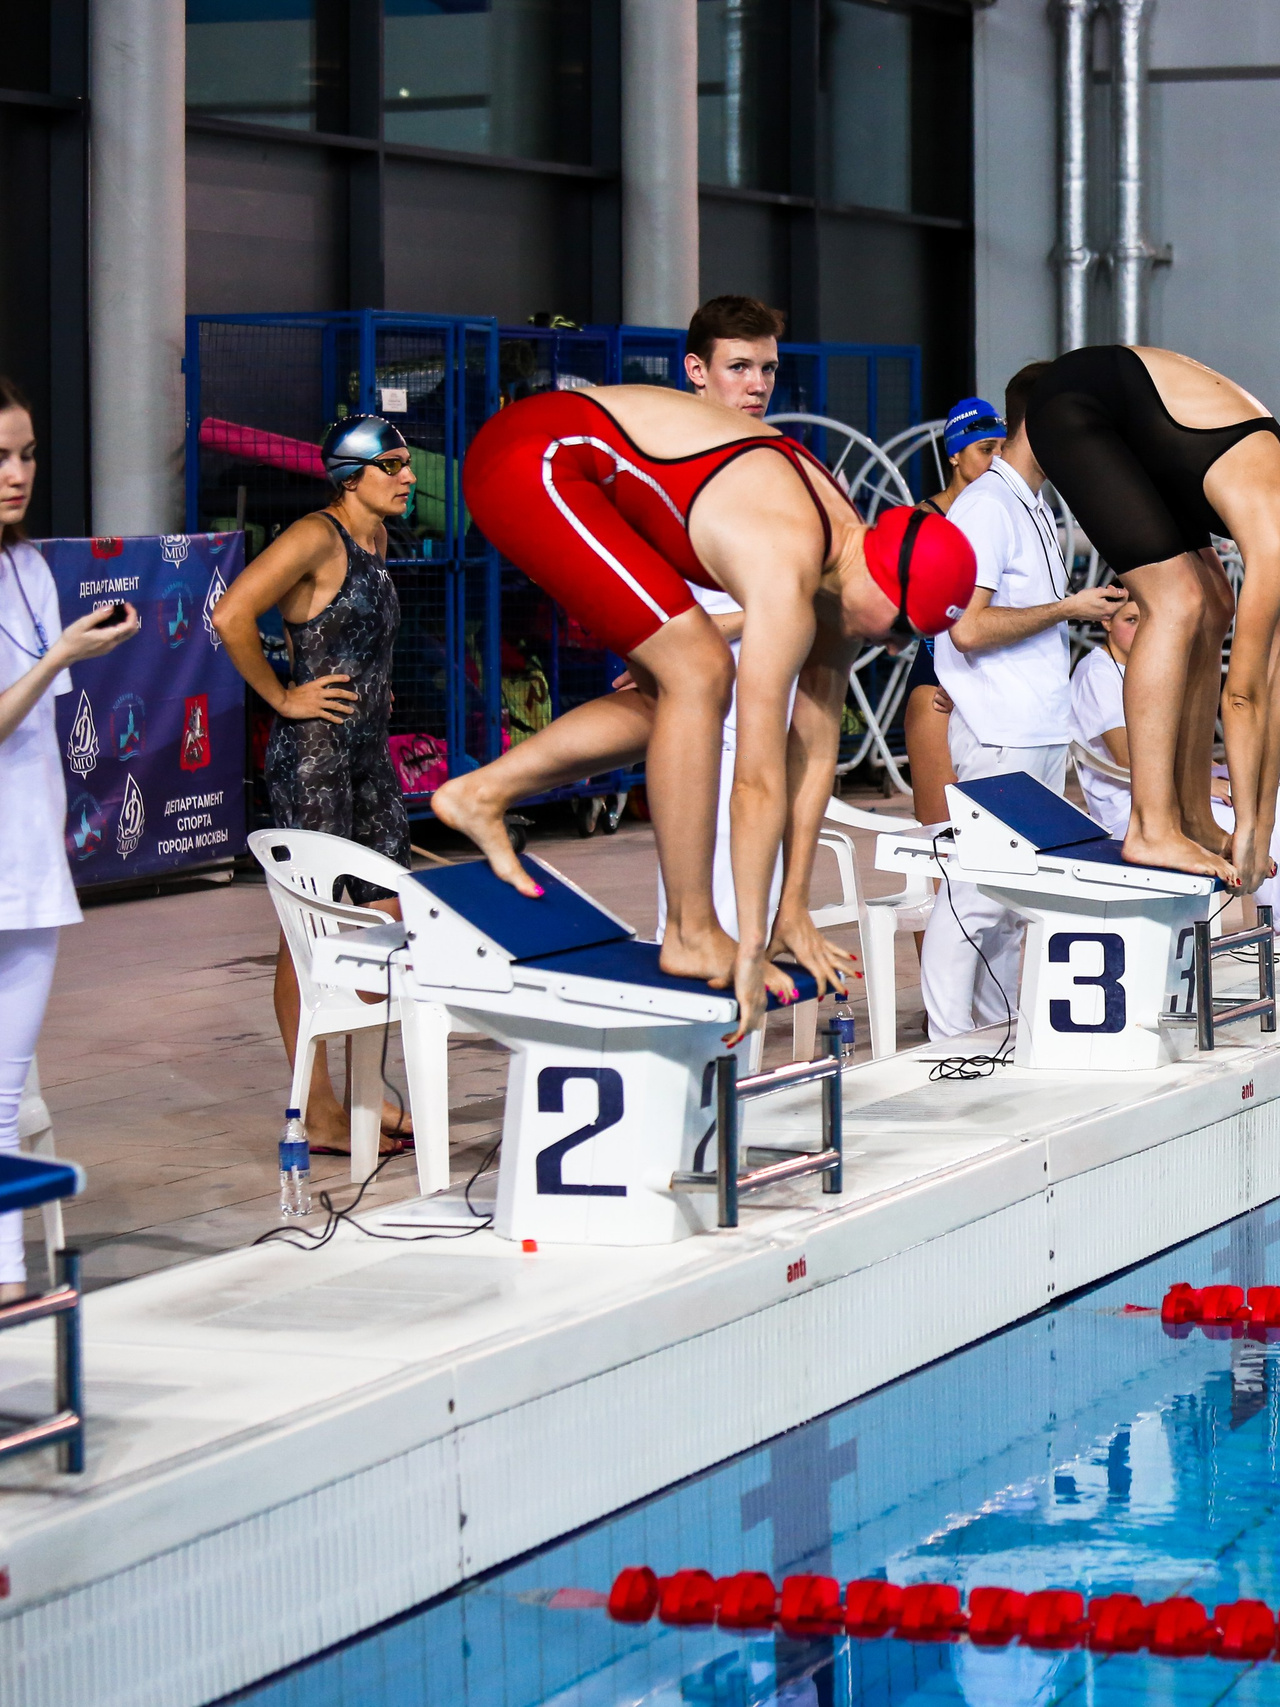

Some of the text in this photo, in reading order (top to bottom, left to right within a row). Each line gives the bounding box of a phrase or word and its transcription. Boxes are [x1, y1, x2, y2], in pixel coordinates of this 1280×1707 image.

[164, 545, 187, 560] МГО
[79, 576, 140, 598] ДЕПАРТАМЕНТ
[72, 755, 94, 770] МГО
[164, 791, 224, 817] ДЕПАРТАМЕНТ
[177, 814, 212, 832] СПОРТА
[119, 837, 137, 852] МГО
[158, 828, 229, 855] ГОРОДА МОСКВЫ
[1049, 933, 1126, 1033] 3
[1241, 1079, 1254, 1100] anti
[536, 1067, 627, 1197] 2
[786, 1254, 806, 1283] anti
